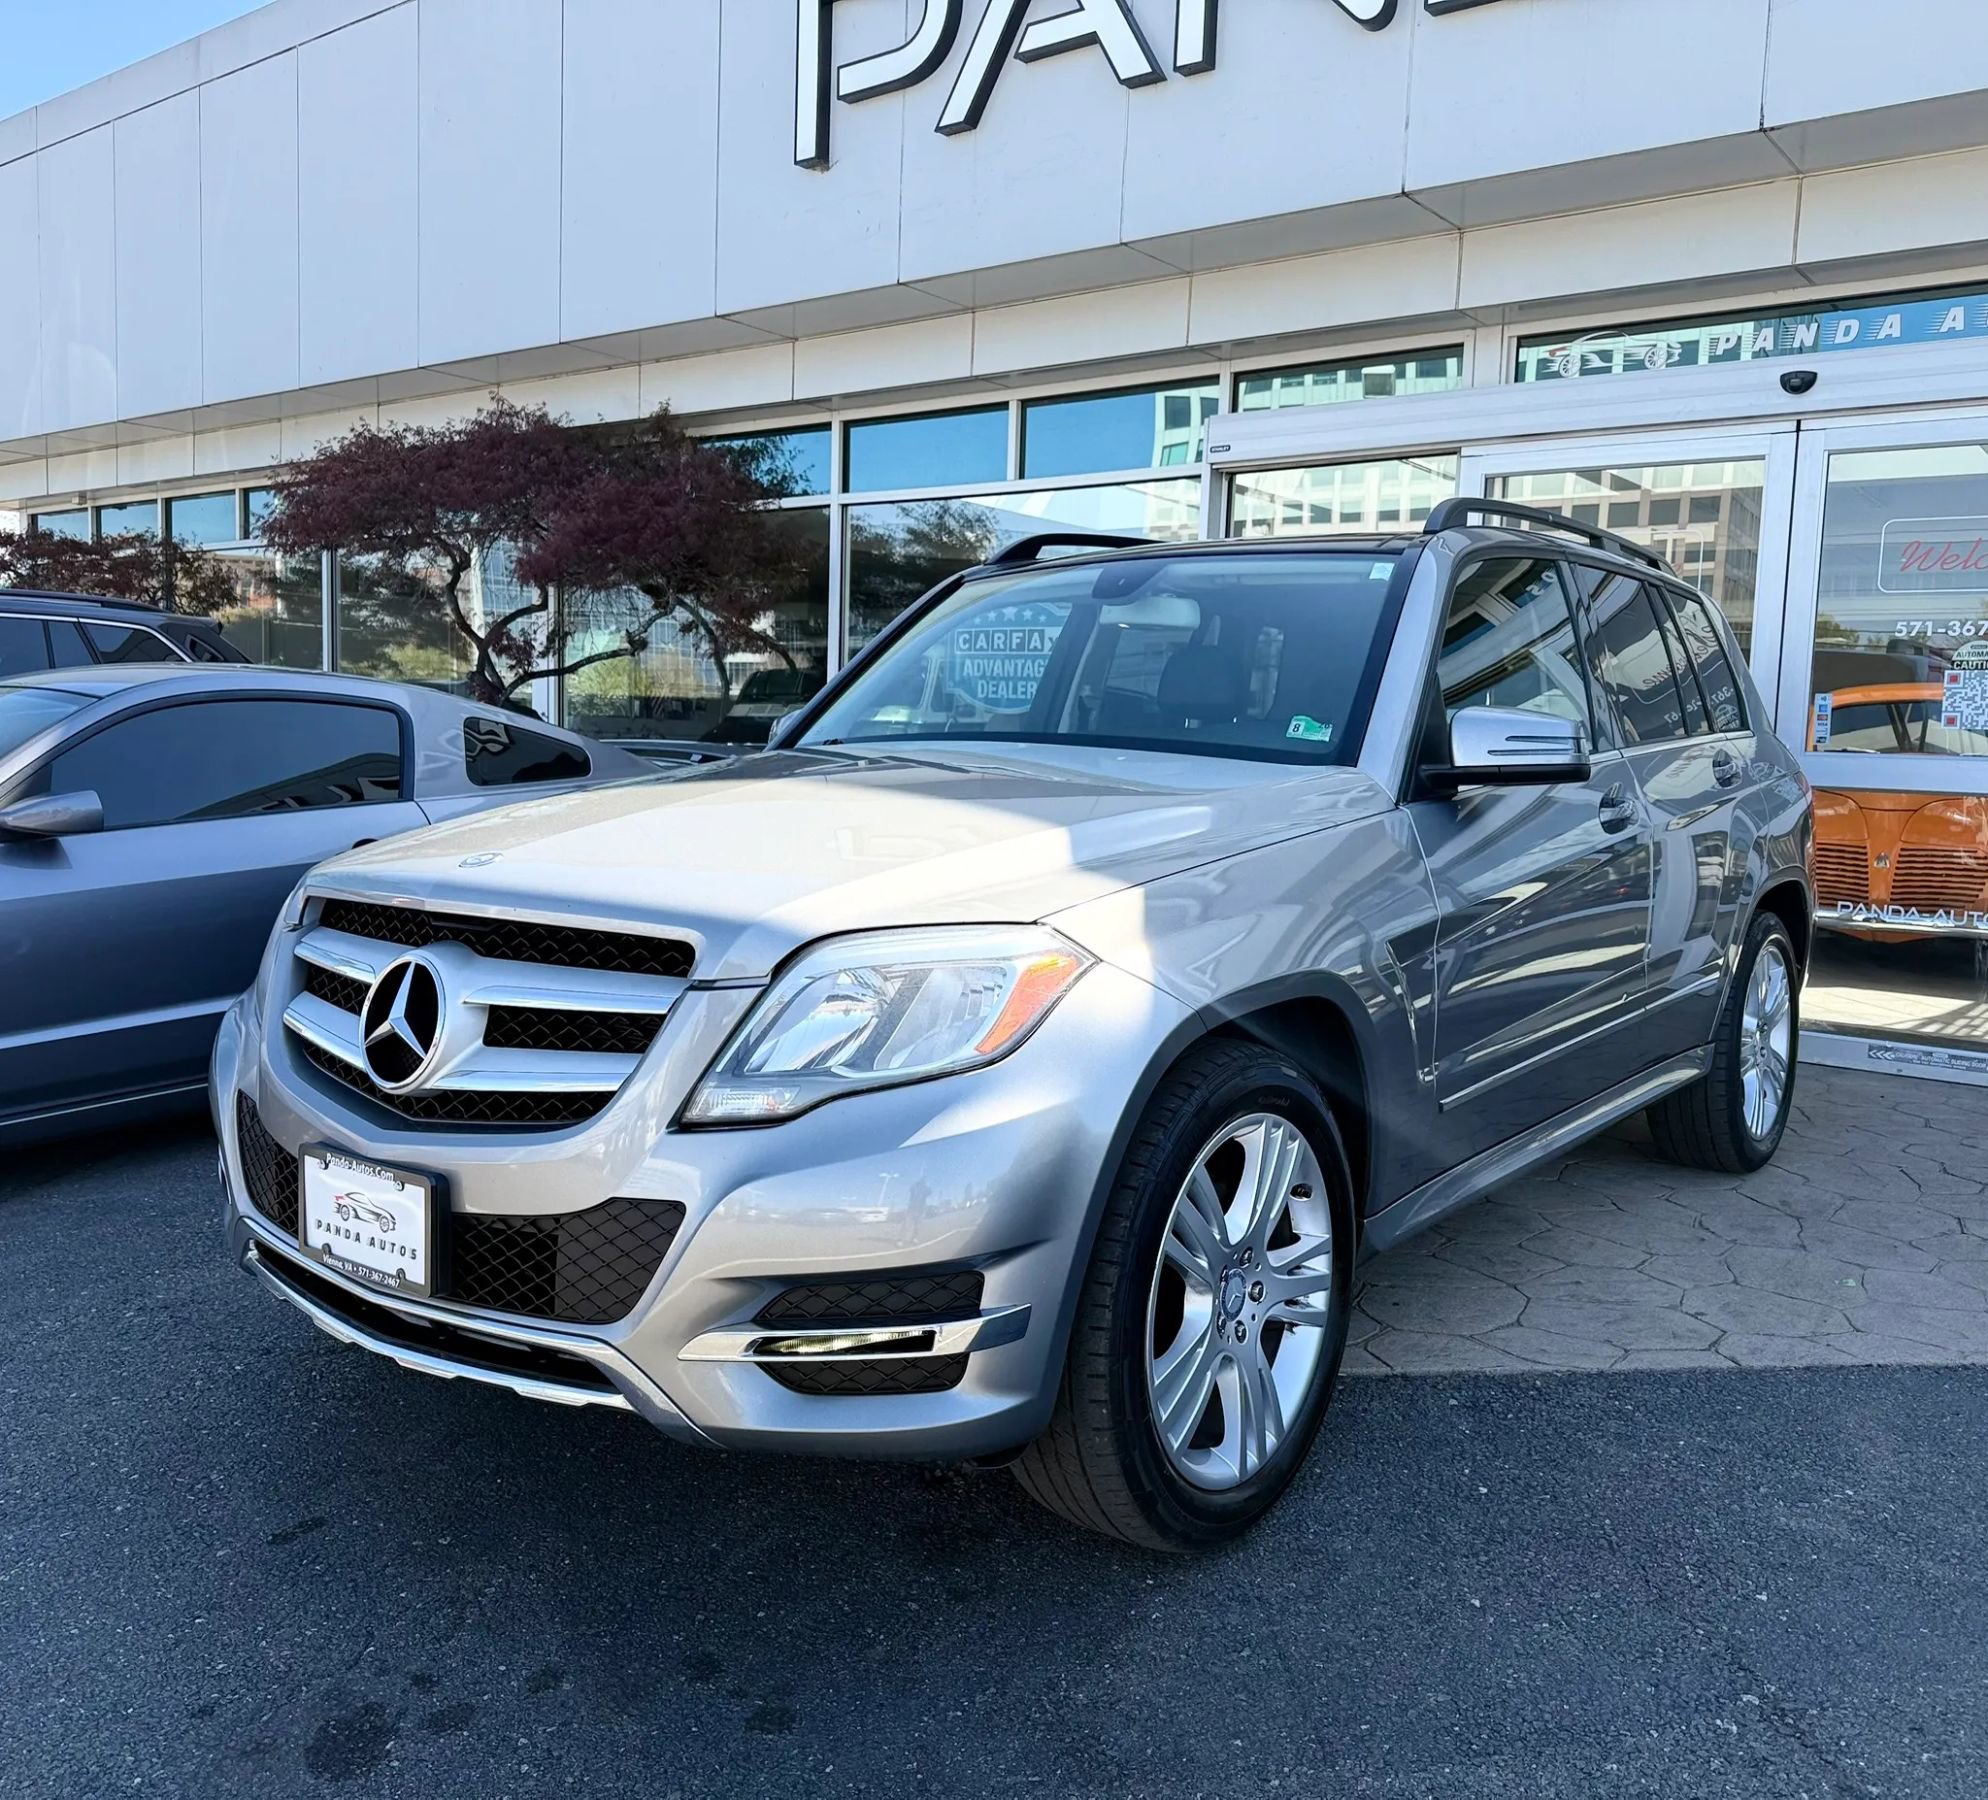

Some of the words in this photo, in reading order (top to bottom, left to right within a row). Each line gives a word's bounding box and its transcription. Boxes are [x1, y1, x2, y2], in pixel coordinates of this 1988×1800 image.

[1710, 313, 1902, 356] PANDA
[963, 658, 1049, 678] ADVANTAG
[1954, 660, 1988, 670] CAUTI
[977, 680, 1037, 700] DEALER
[326, 1152, 395, 1181] Panda-Autos.Com
[315, 1219, 361, 1243] PANDA
[369, 1236, 417, 1260] AUTOS
